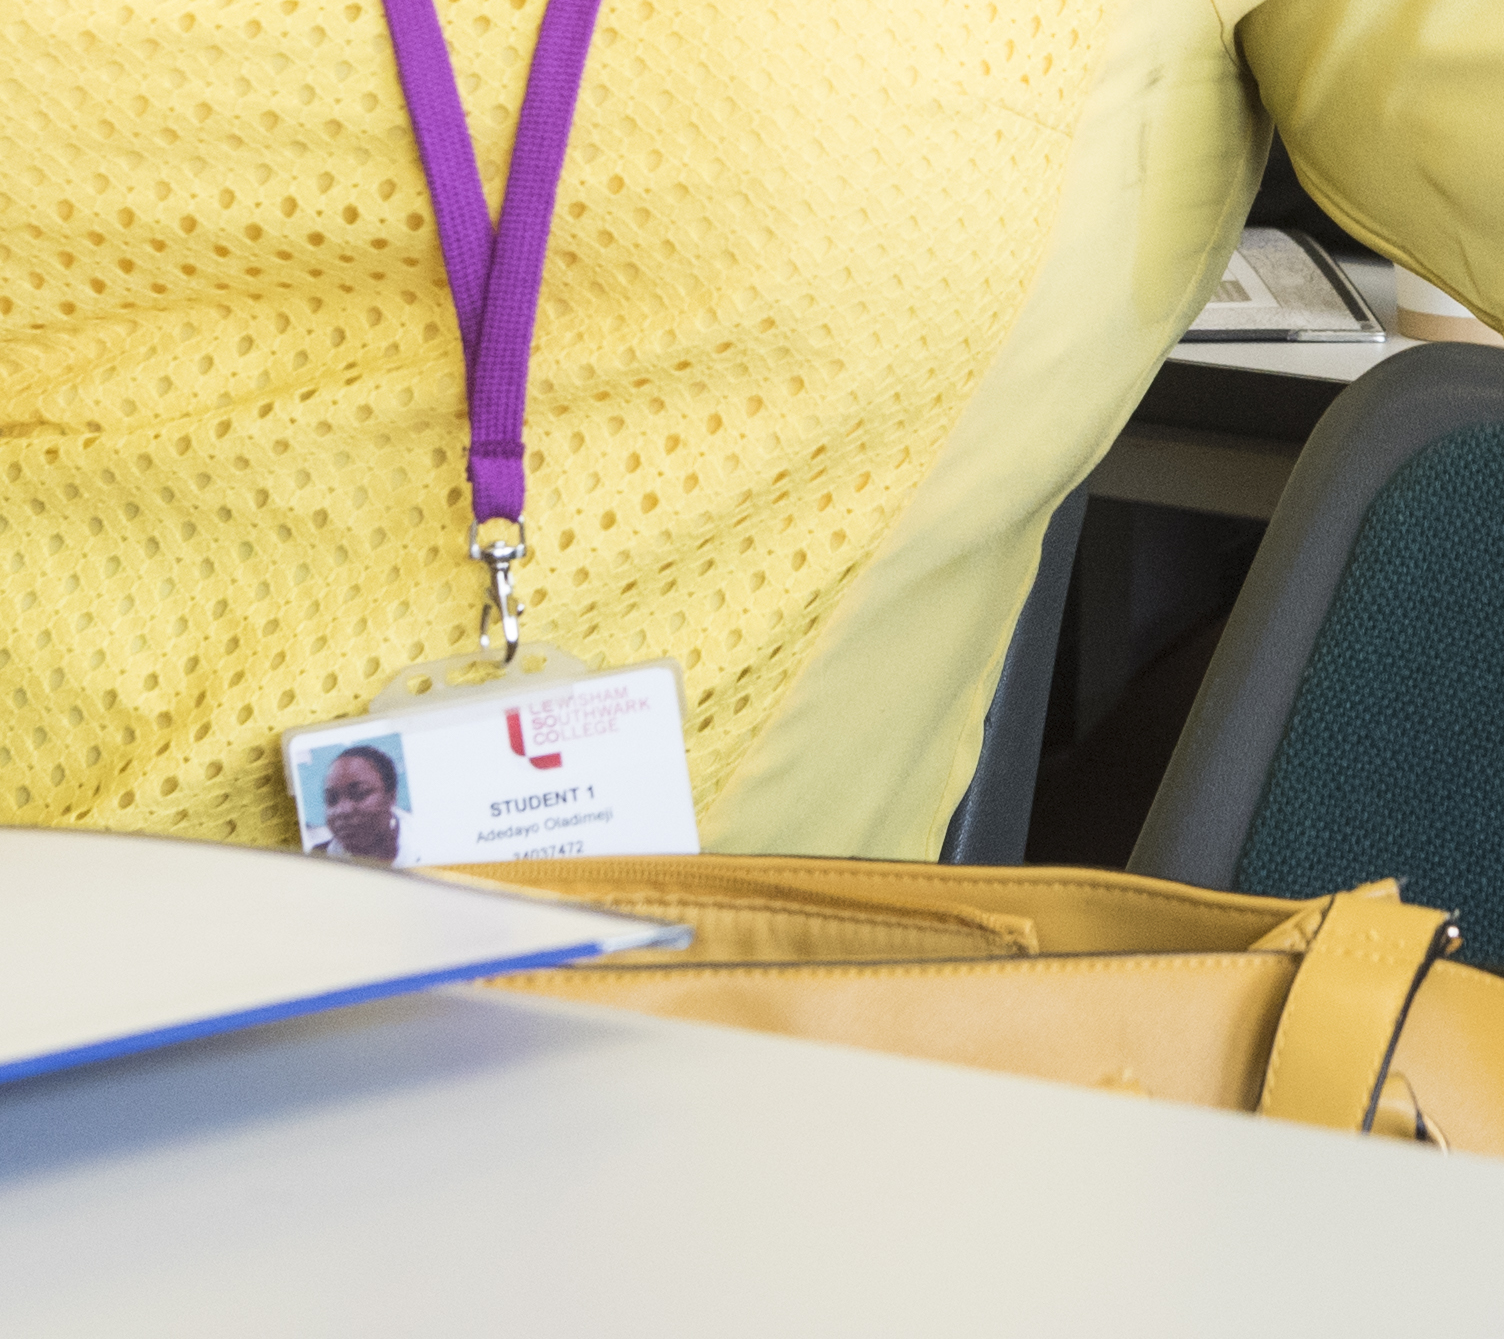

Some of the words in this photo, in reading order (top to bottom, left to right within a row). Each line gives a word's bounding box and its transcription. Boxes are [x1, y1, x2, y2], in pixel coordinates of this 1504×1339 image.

[529, 685, 628, 715] LEWISHAM
[532, 697, 650, 730] SOUTHWARK
[533, 718, 619, 745] COLLEGE
[490, 786, 580, 818] STUDENT
[586, 784, 595, 800] 1
[476, 822, 540, 844] Adedayo
[543, 806, 614, 831] Oladimeji
